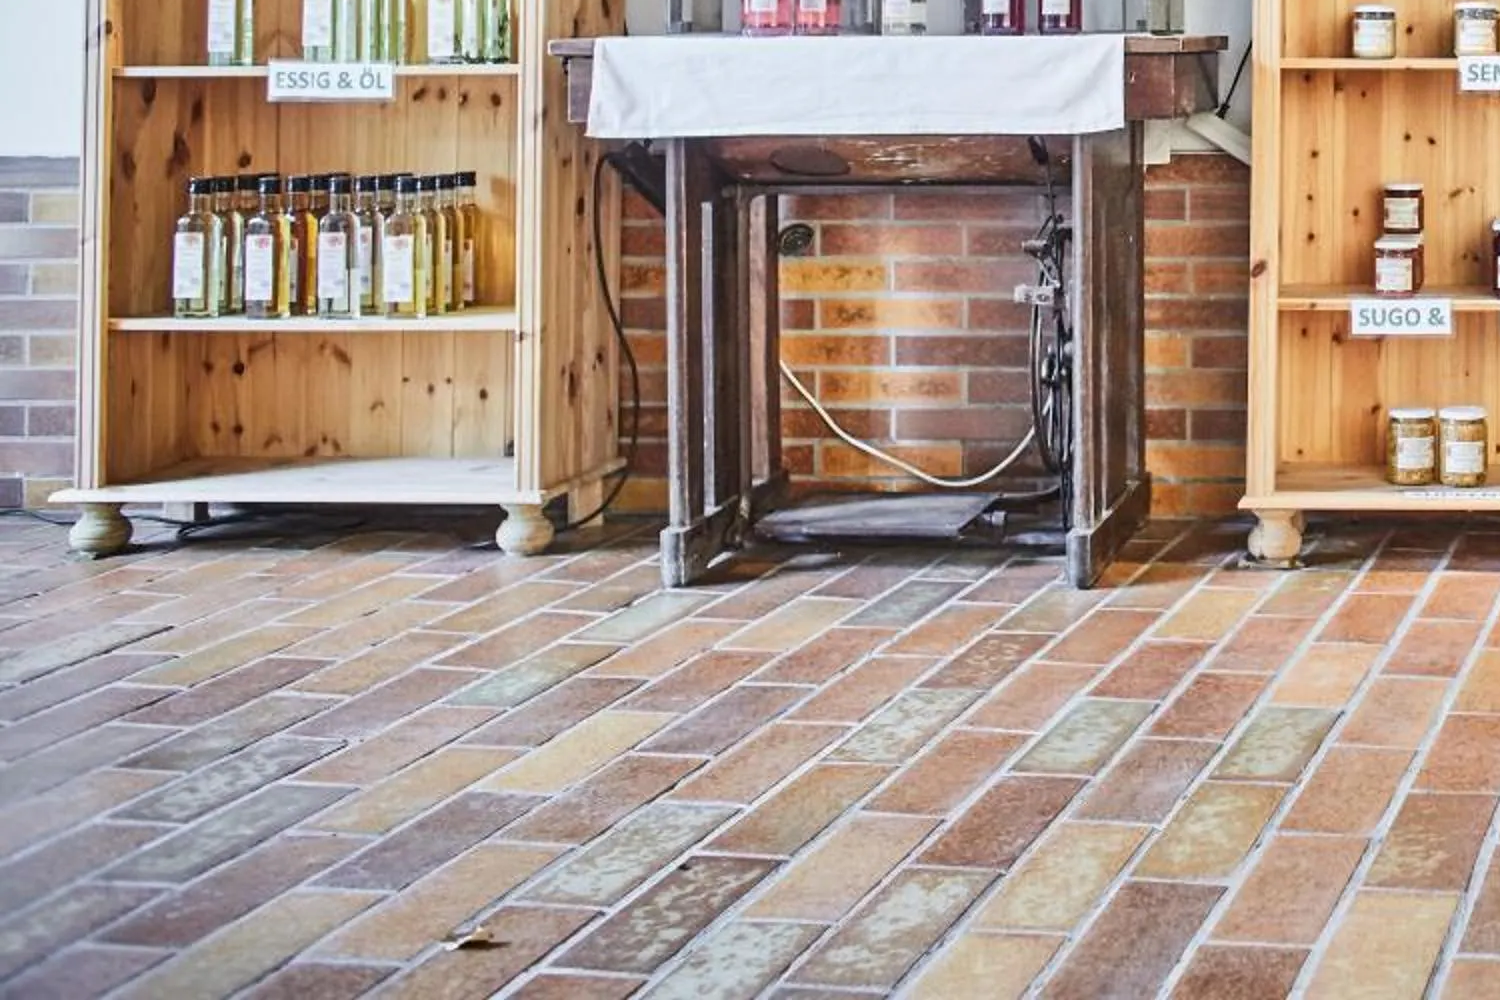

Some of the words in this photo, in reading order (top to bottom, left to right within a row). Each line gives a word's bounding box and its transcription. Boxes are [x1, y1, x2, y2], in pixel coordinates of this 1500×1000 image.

[275, 71, 331, 89] ESSIG
[336, 71, 354, 89] &
[359, 65, 387, 89] ÖL
[1358, 307, 1421, 327] SUGO
[1427, 307, 1447, 327] &
